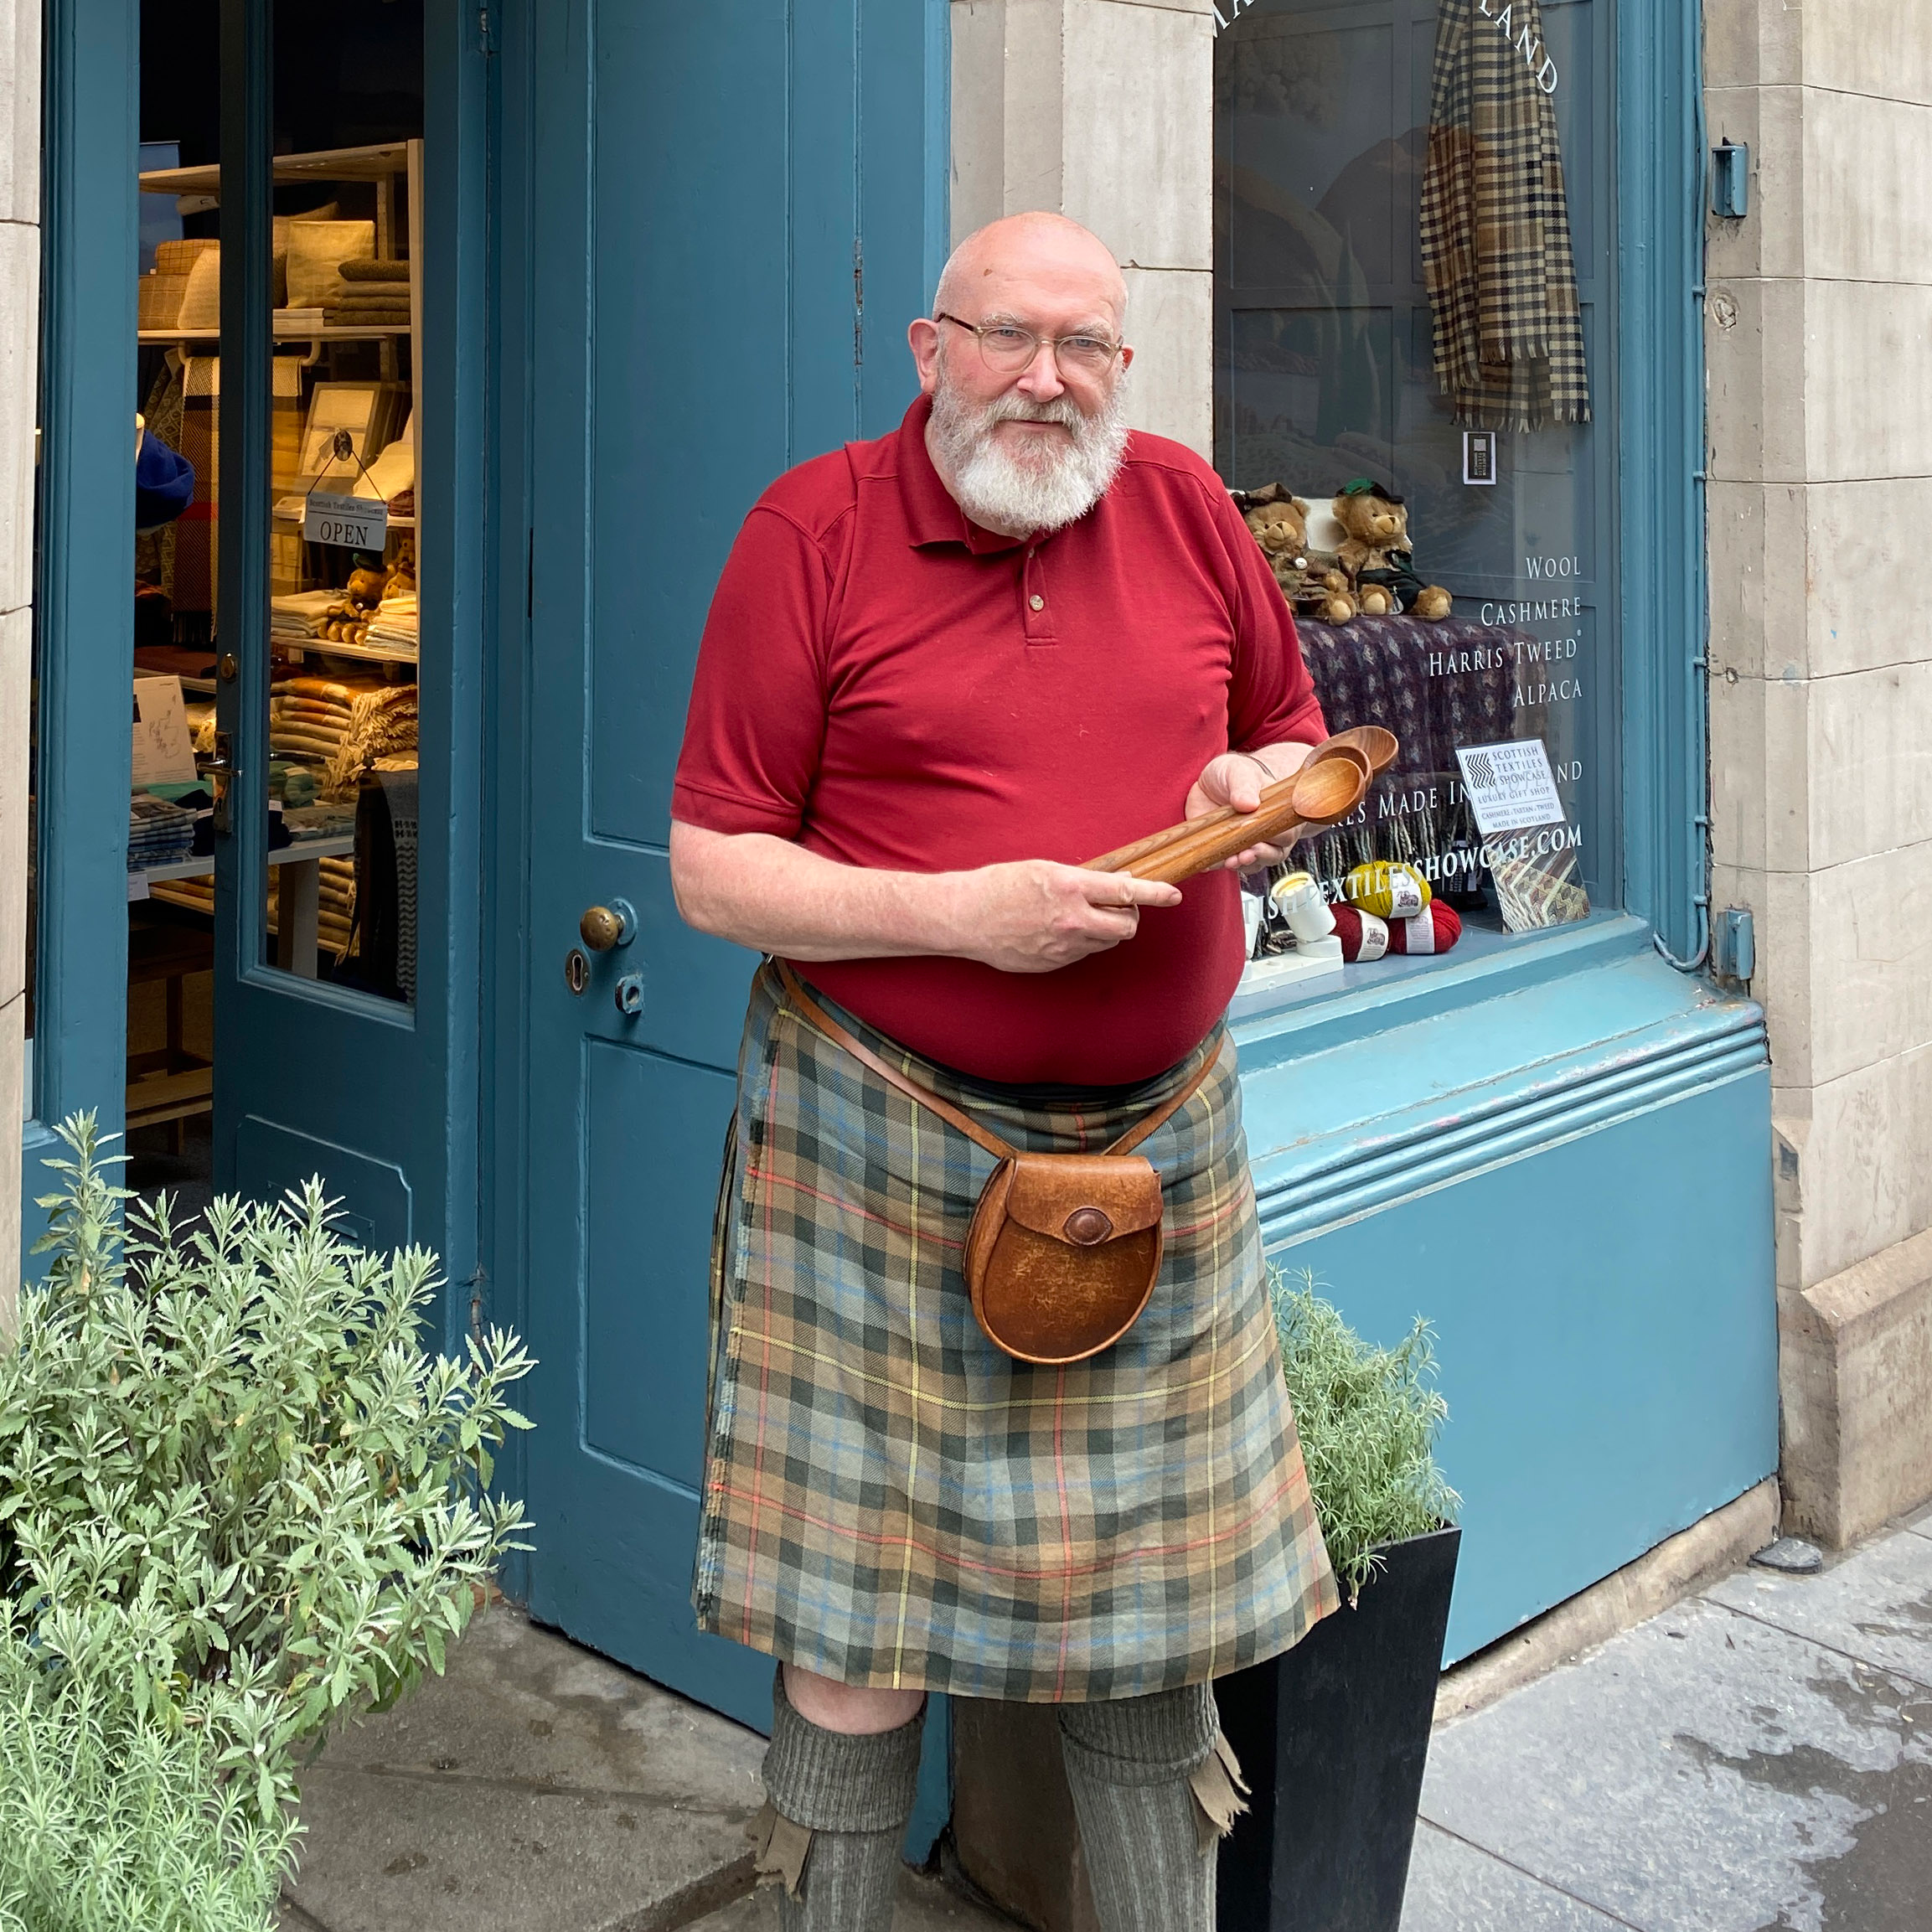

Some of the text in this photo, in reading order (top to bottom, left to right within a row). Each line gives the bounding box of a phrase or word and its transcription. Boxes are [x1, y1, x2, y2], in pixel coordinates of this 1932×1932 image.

[320, 520, 369, 546] OPEN
[1526, 555, 1582, 579] WOOL
[1480, 597, 1582, 627] CASHMERE
[1428, 647, 1505, 678] HARRIS
[1512, 677, 1583, 708] ALPACA
[1491, 746, 1539, 762] SCOTTISH
[1495, 757, 1543, 773] TEXTILES
[1499, 770, 1547, 786] SHOWCASE
[1378, 788, 1438, 819] MADE
[1477, 786, 1550, 805] LUXURY GIFT SHOP
[1481, 808, 1511, 820] CASHMERE
[1536, 802, 1556, 813] TWEED
[1492, 813, 1552, 829] MADE IN SCOTLAND
